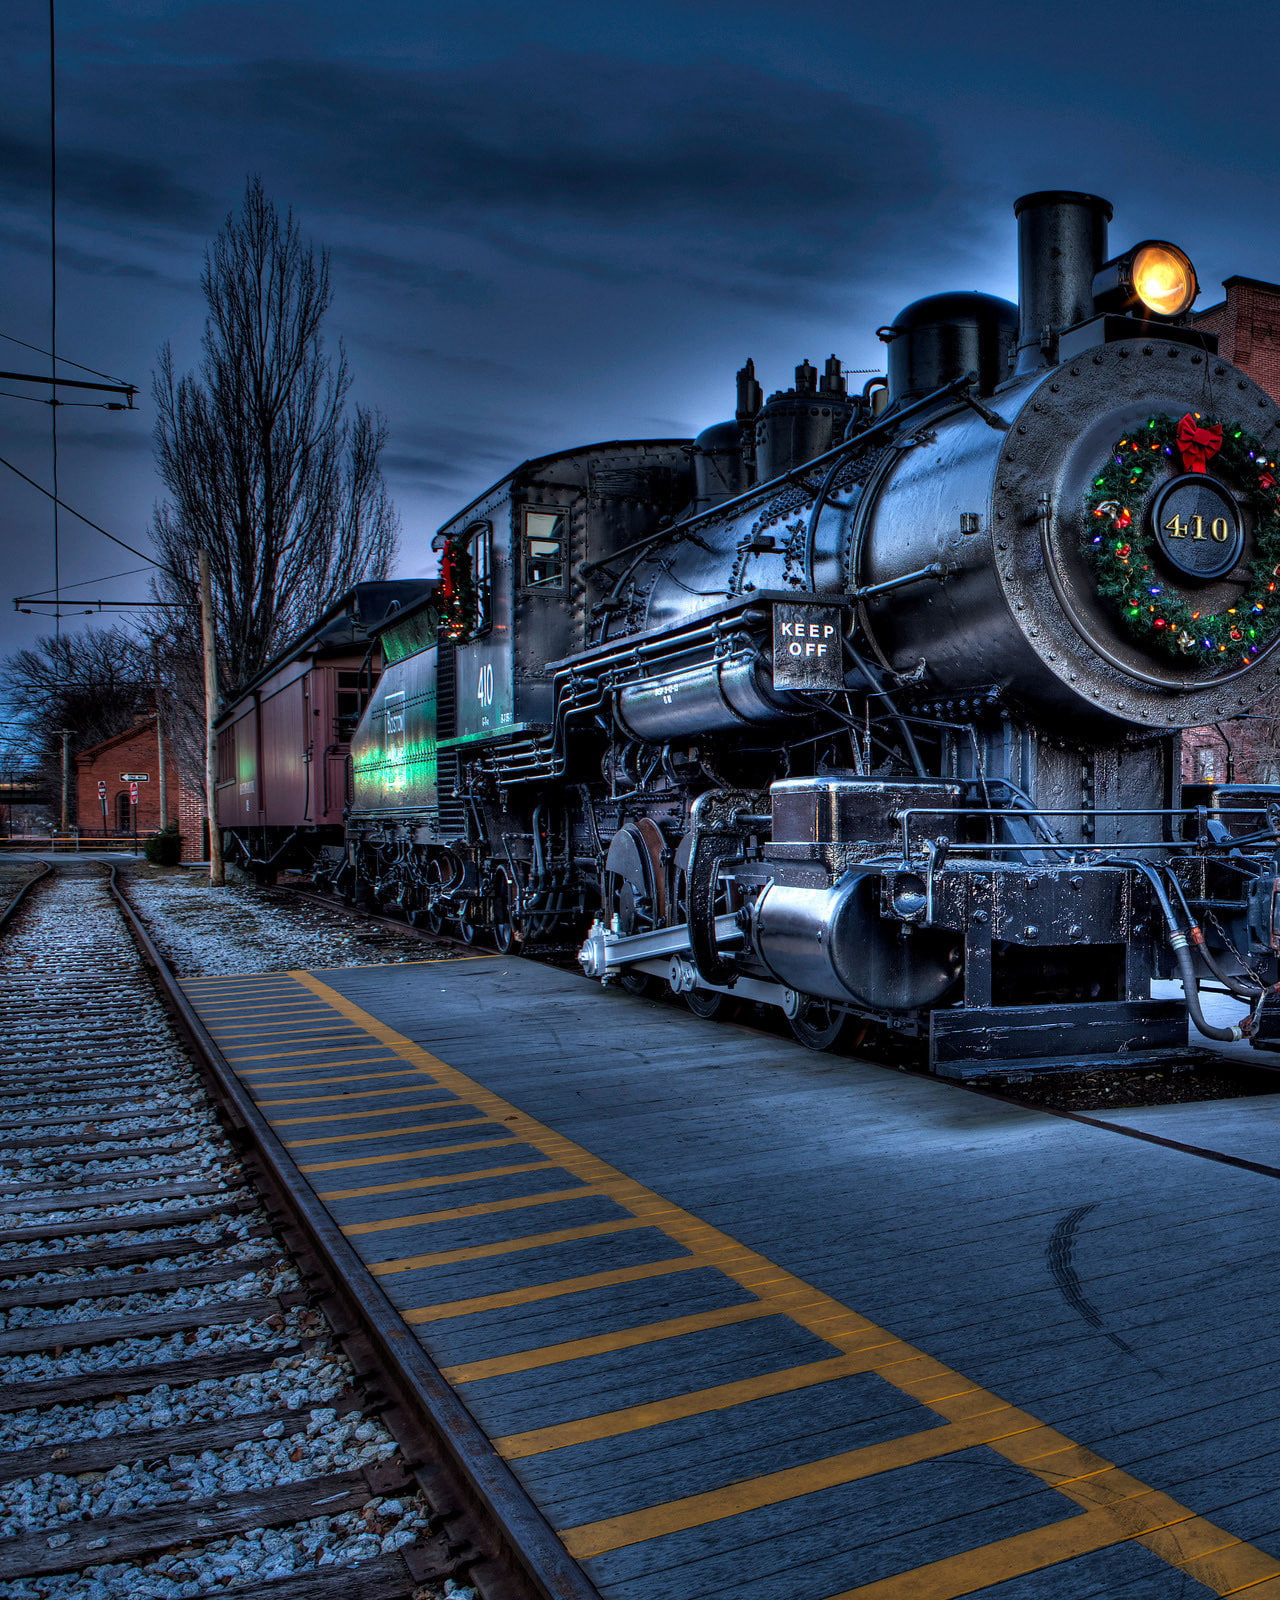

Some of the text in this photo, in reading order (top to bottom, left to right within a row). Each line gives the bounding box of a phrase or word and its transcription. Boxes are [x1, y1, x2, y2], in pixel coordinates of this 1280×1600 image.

[1165, 513, 1229, 543] 410
[781, 622, 835, 639] KEEP
[789, 642, 828, 657] OFF
[477, 663, 494, 708] 410
